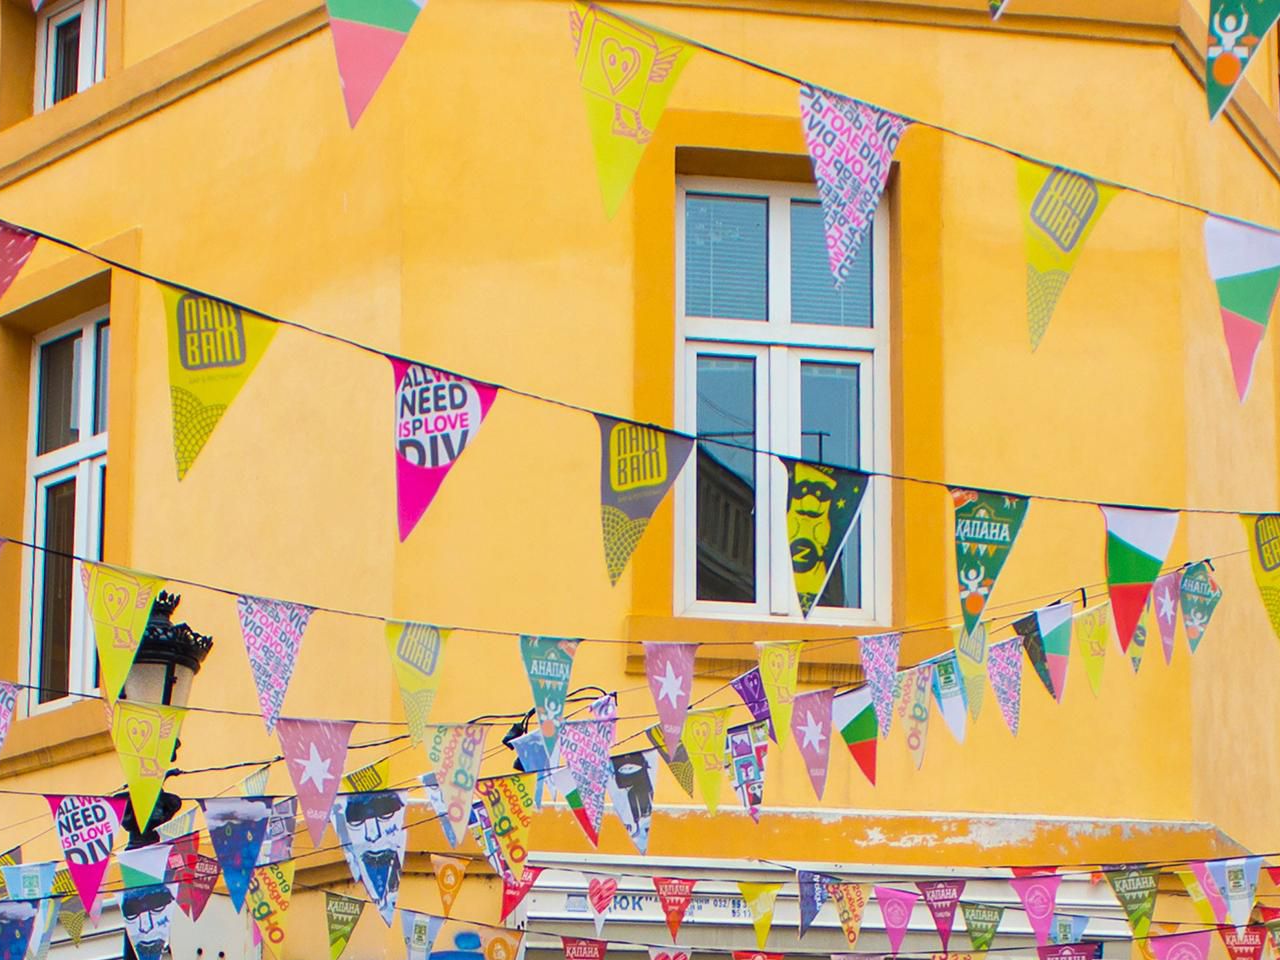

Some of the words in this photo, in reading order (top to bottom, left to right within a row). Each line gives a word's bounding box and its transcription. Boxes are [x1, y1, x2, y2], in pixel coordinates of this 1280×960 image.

[400, 383, 468, 418] NEED
[956, 519, 1011, 542] КАПАНА
[57, 806, 107, 836] NEED
[1115, 875, 1157, 893] КАПАНА
[566, 945, 600, 960] КАПАНА
